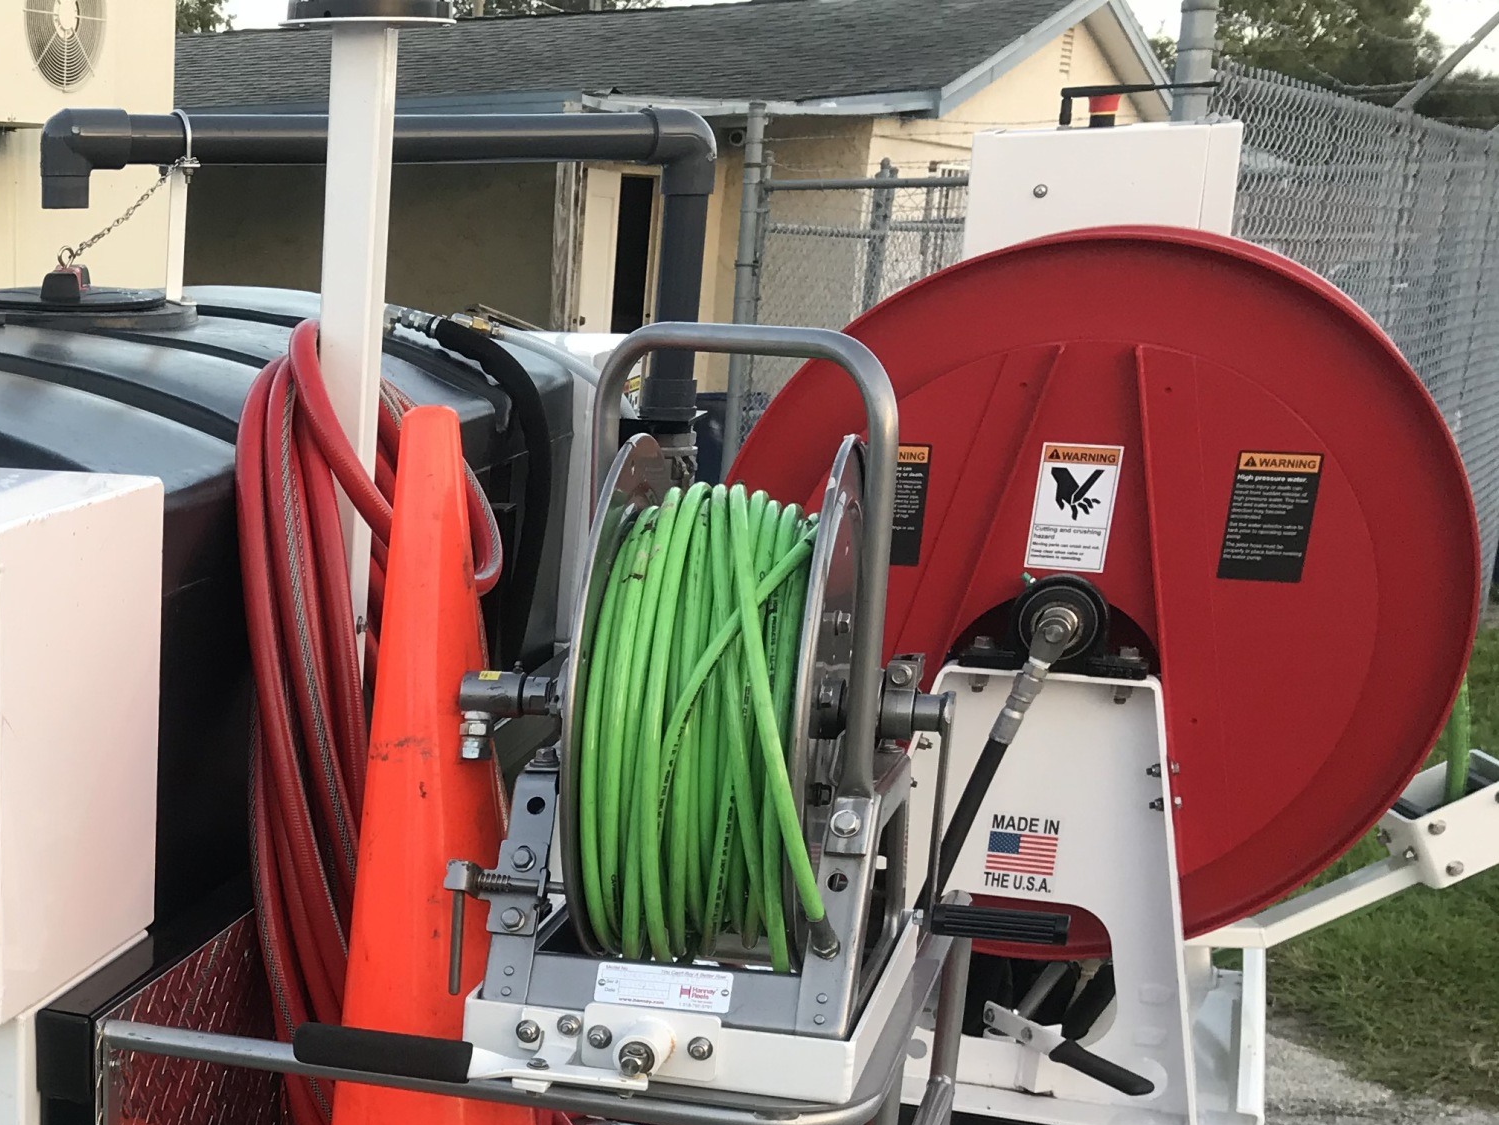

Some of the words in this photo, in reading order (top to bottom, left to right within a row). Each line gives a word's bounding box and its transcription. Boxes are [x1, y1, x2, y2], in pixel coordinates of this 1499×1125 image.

[898, 452, 926, 461] NING
[1062, 452, 1116, 463] WARNING
[1259, 458, 1317, 469] WARNING
[1072, 528, 1101, 536] crushing
[991, 814, 1039, 833] MADE
[1044, 819, 1060, 835] IN
[984, 871, 1010, 888] THE
[1013, 875, 1051, 893] U.S.A.
